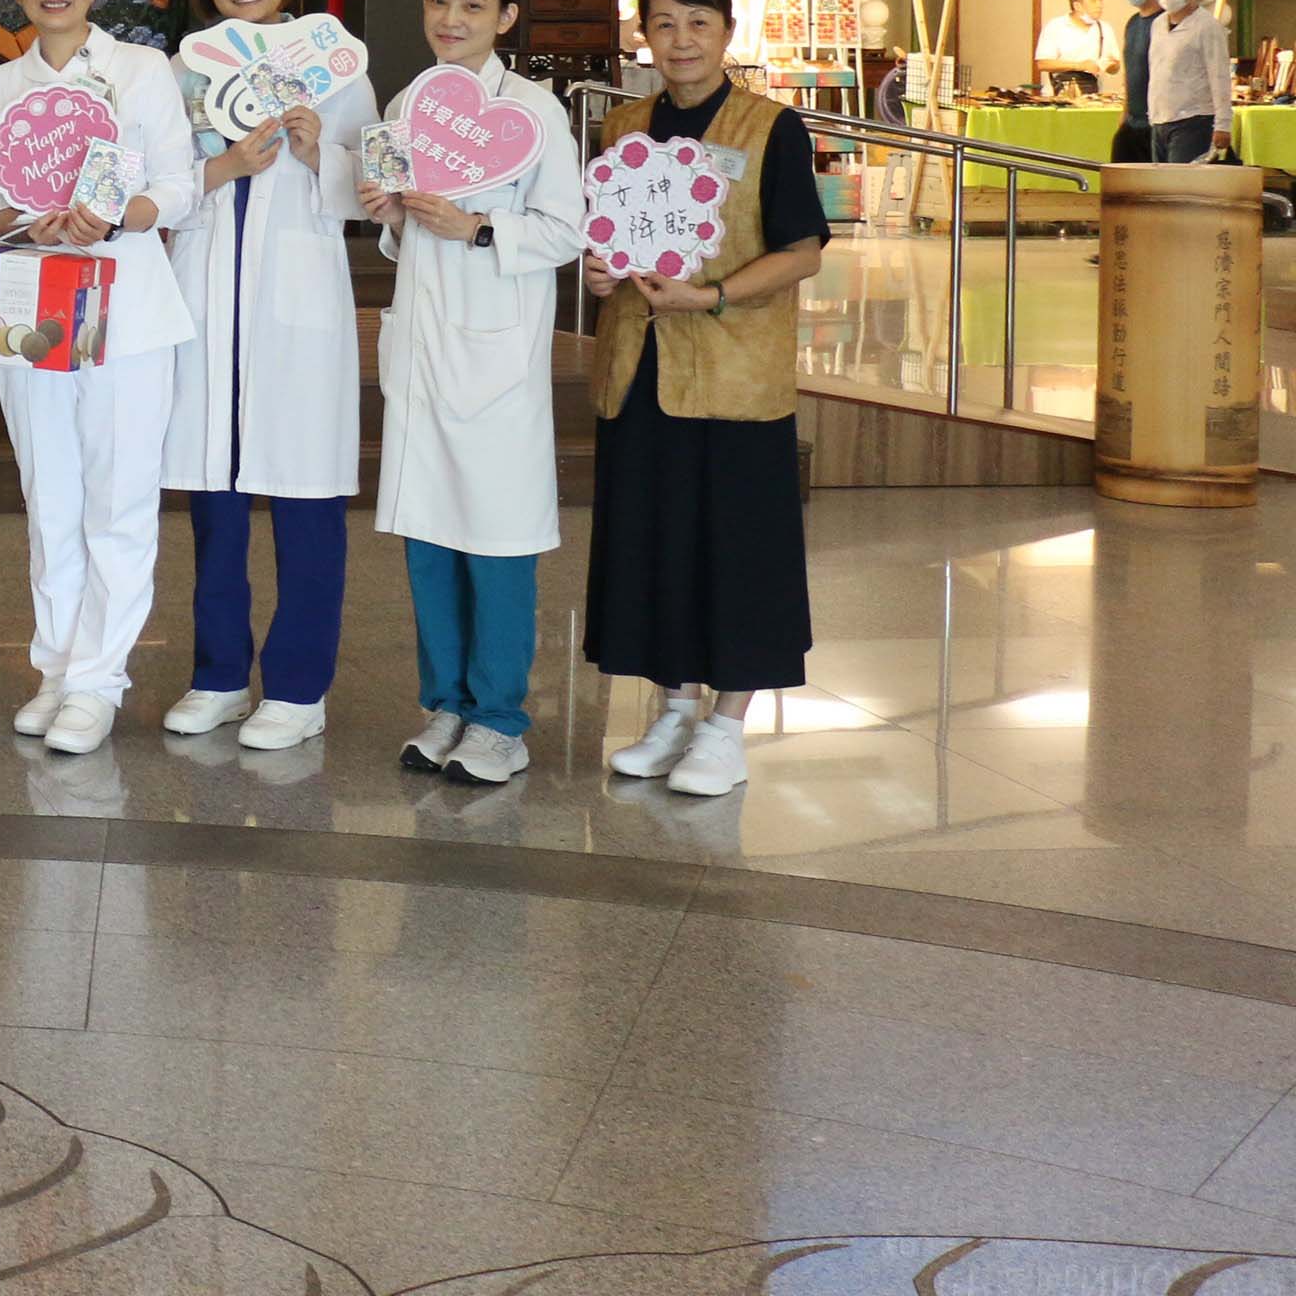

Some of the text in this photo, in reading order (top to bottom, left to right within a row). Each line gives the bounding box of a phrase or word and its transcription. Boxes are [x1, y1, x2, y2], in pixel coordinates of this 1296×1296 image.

[311, 22, 339, 50] 好
[24, 120, 76, 156] Happy
[411, 133, 485, 184] 最美女神
[611, 176, 671, 208] 女神
